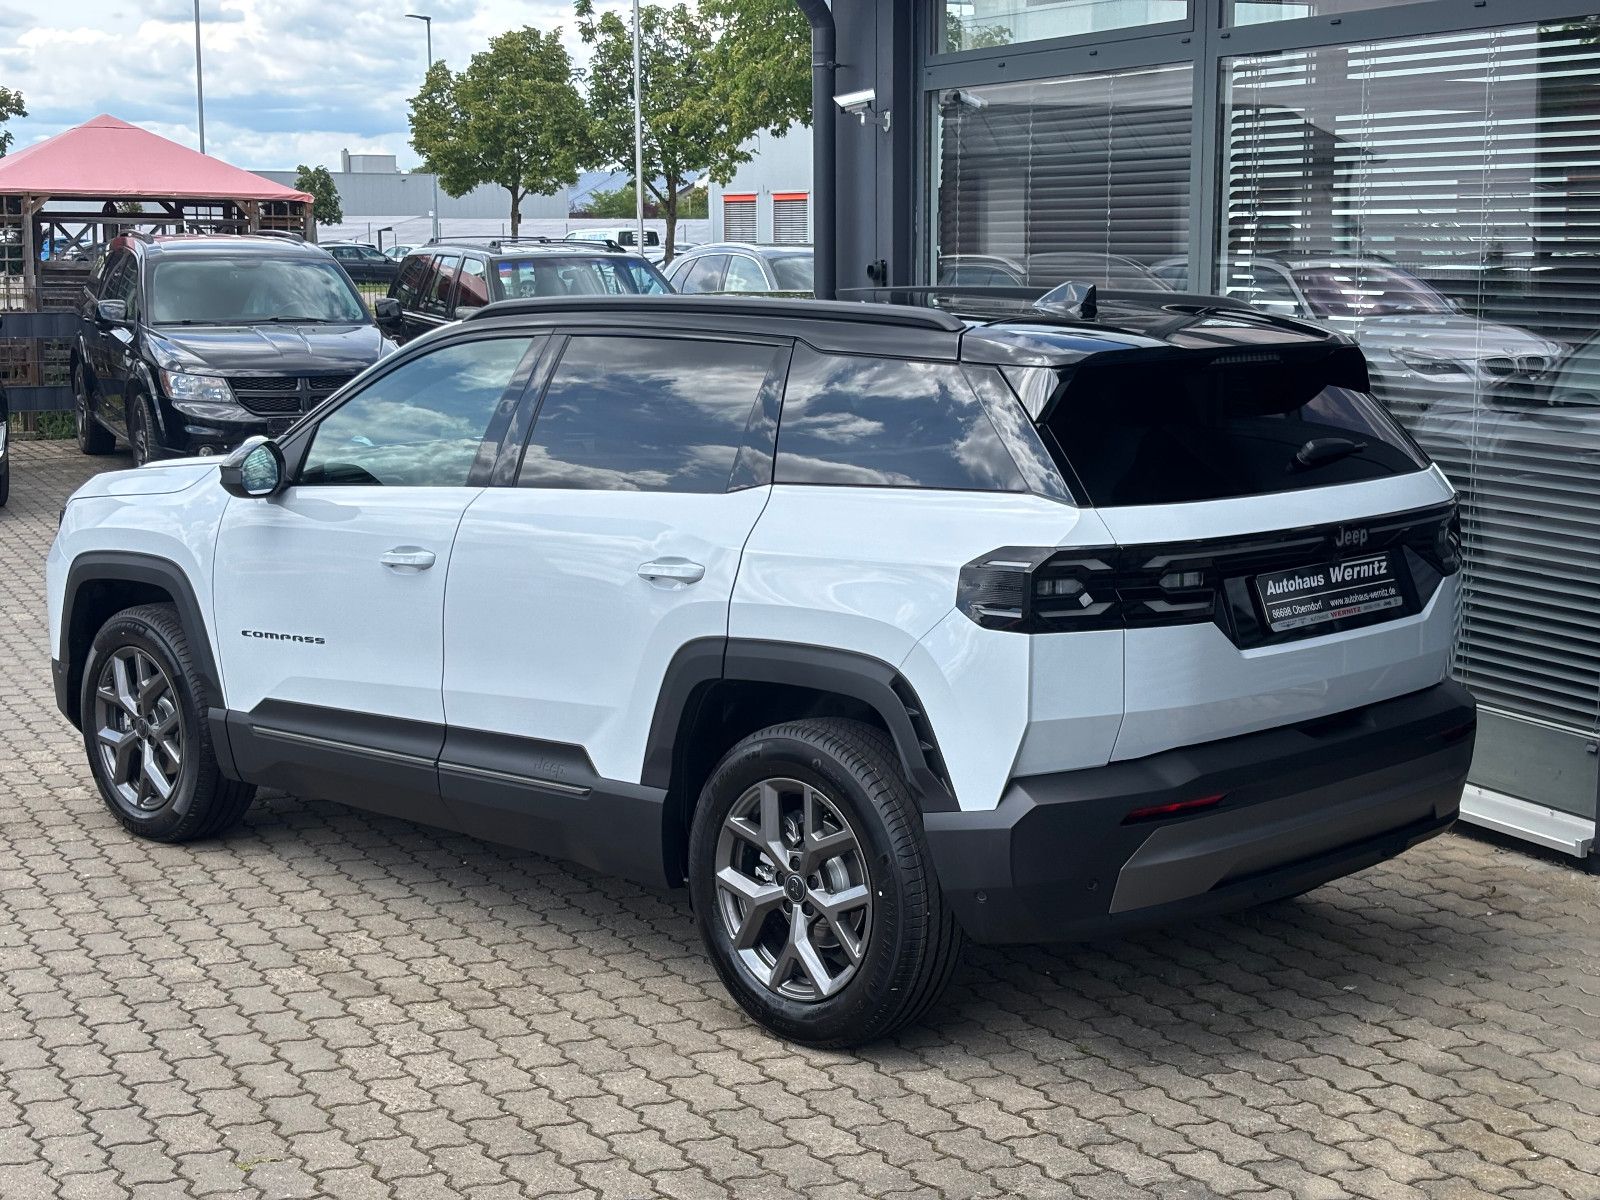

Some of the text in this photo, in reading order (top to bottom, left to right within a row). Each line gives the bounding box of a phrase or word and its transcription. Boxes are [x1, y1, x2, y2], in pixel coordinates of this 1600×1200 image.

[1335, 525, 1368, 547] Jeep
[1266, 557, 1387, 596] Autohaus Wernitz
[1292, 600, 1323, 616] Oberndorf
[1329, 586, 1396, 607] www.autohaus-wernitz.de
[1329, 606, 1361, 619] WERNITZ
[241, 630, 325, 644] COMPASS
[534, 751, 568, 779] Jeep
